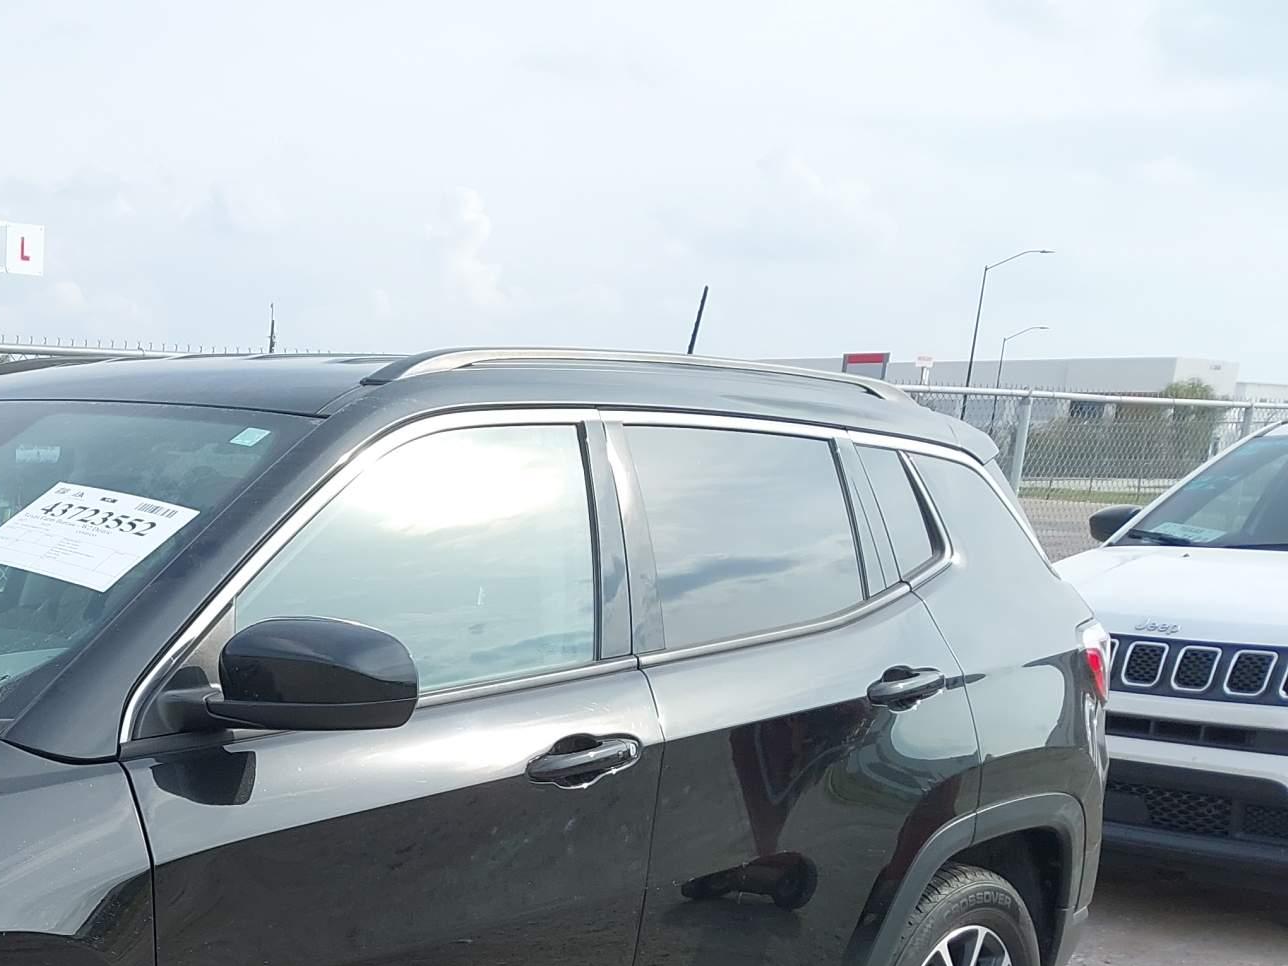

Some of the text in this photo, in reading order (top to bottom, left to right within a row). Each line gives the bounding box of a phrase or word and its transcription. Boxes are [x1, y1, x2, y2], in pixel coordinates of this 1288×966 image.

[20, 236, 31, 261] L
[40, 501, 157, 537] 43723552
[1134, 616, 1182, 636] Jeep
